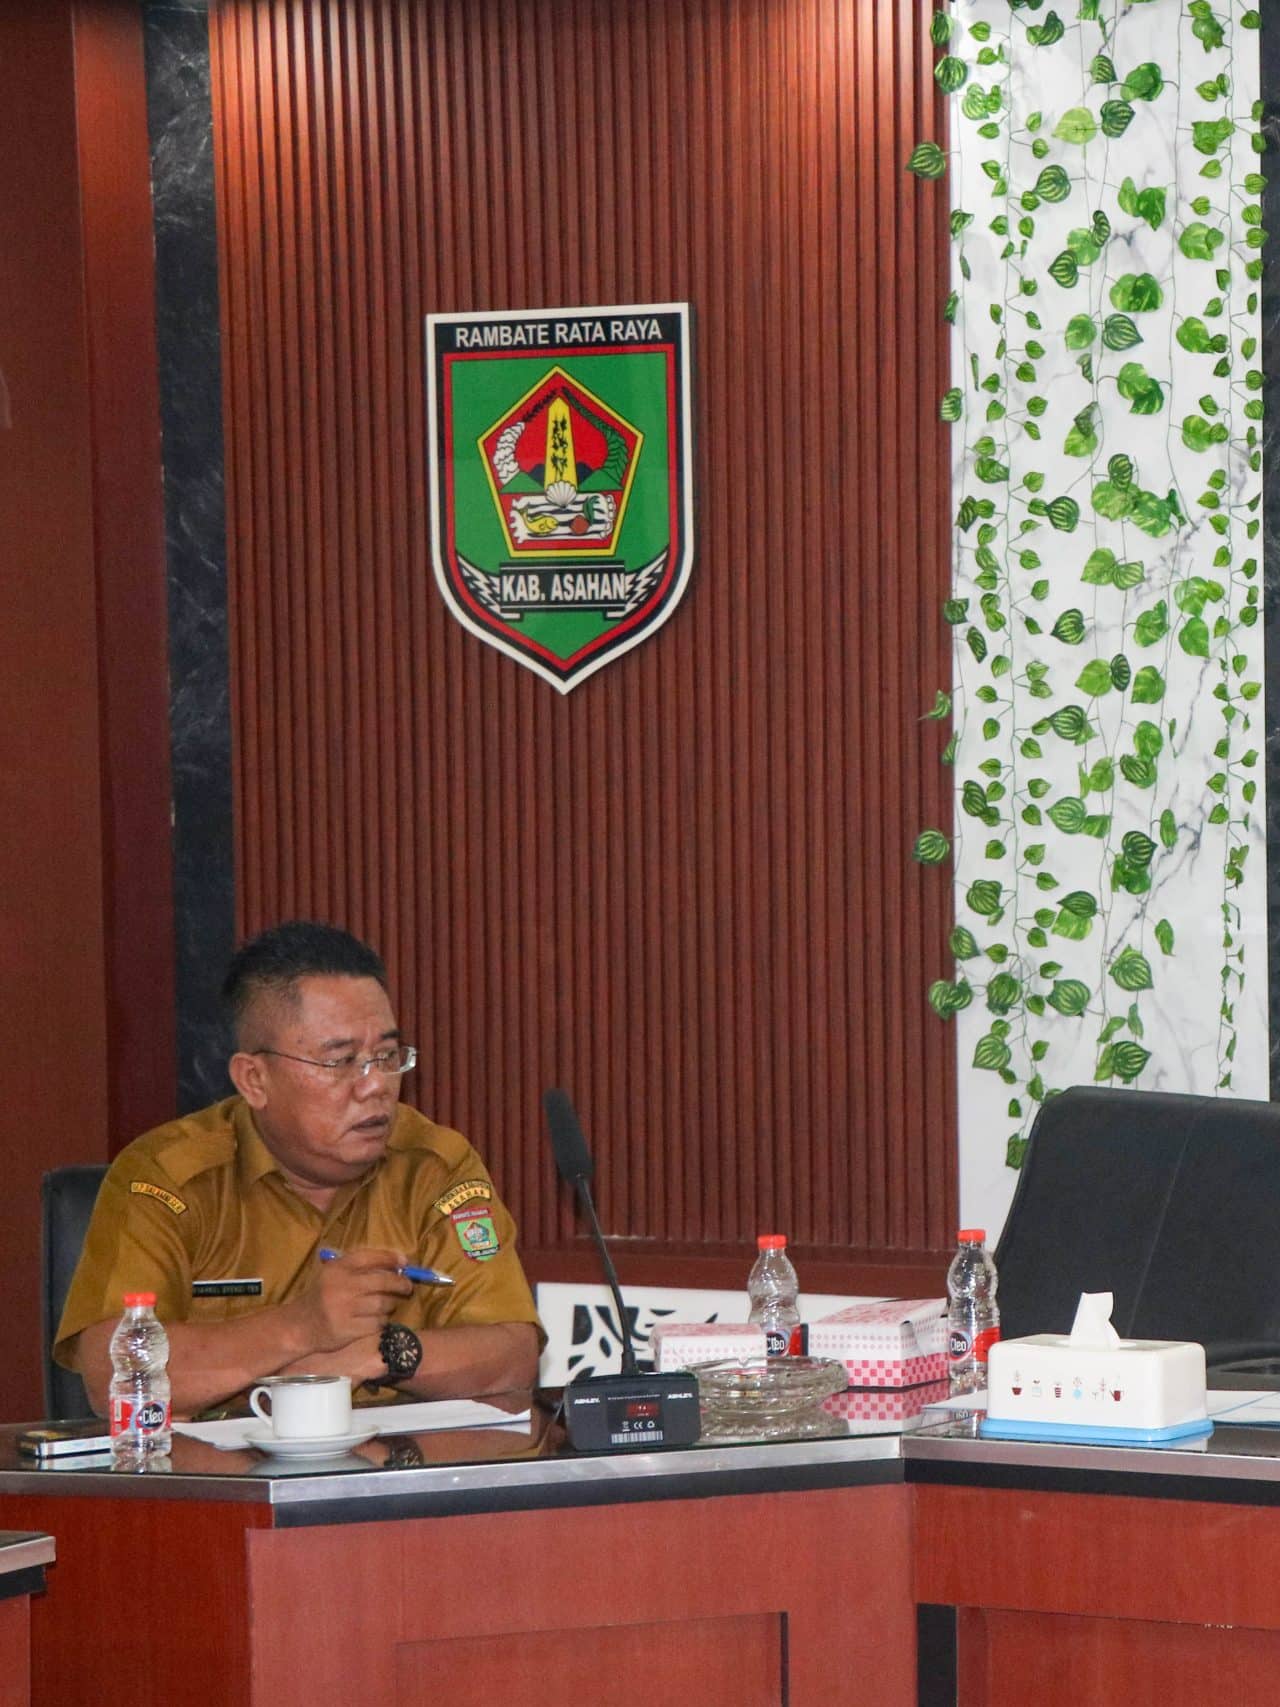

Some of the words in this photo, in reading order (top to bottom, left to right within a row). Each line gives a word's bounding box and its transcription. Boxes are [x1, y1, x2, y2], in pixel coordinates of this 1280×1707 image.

[455, 324, 550, 348] RAMBATE
[555, 321, 607, 344] RATA
[610, 318, 663, 342] RAYA
[502, 574, 546, 601] KAB.
[551, 573, 625, 601] ASAHAN
[950, 1337, 967, 1351] Cleo
[142, 1407, 163, 1424] Cleo
